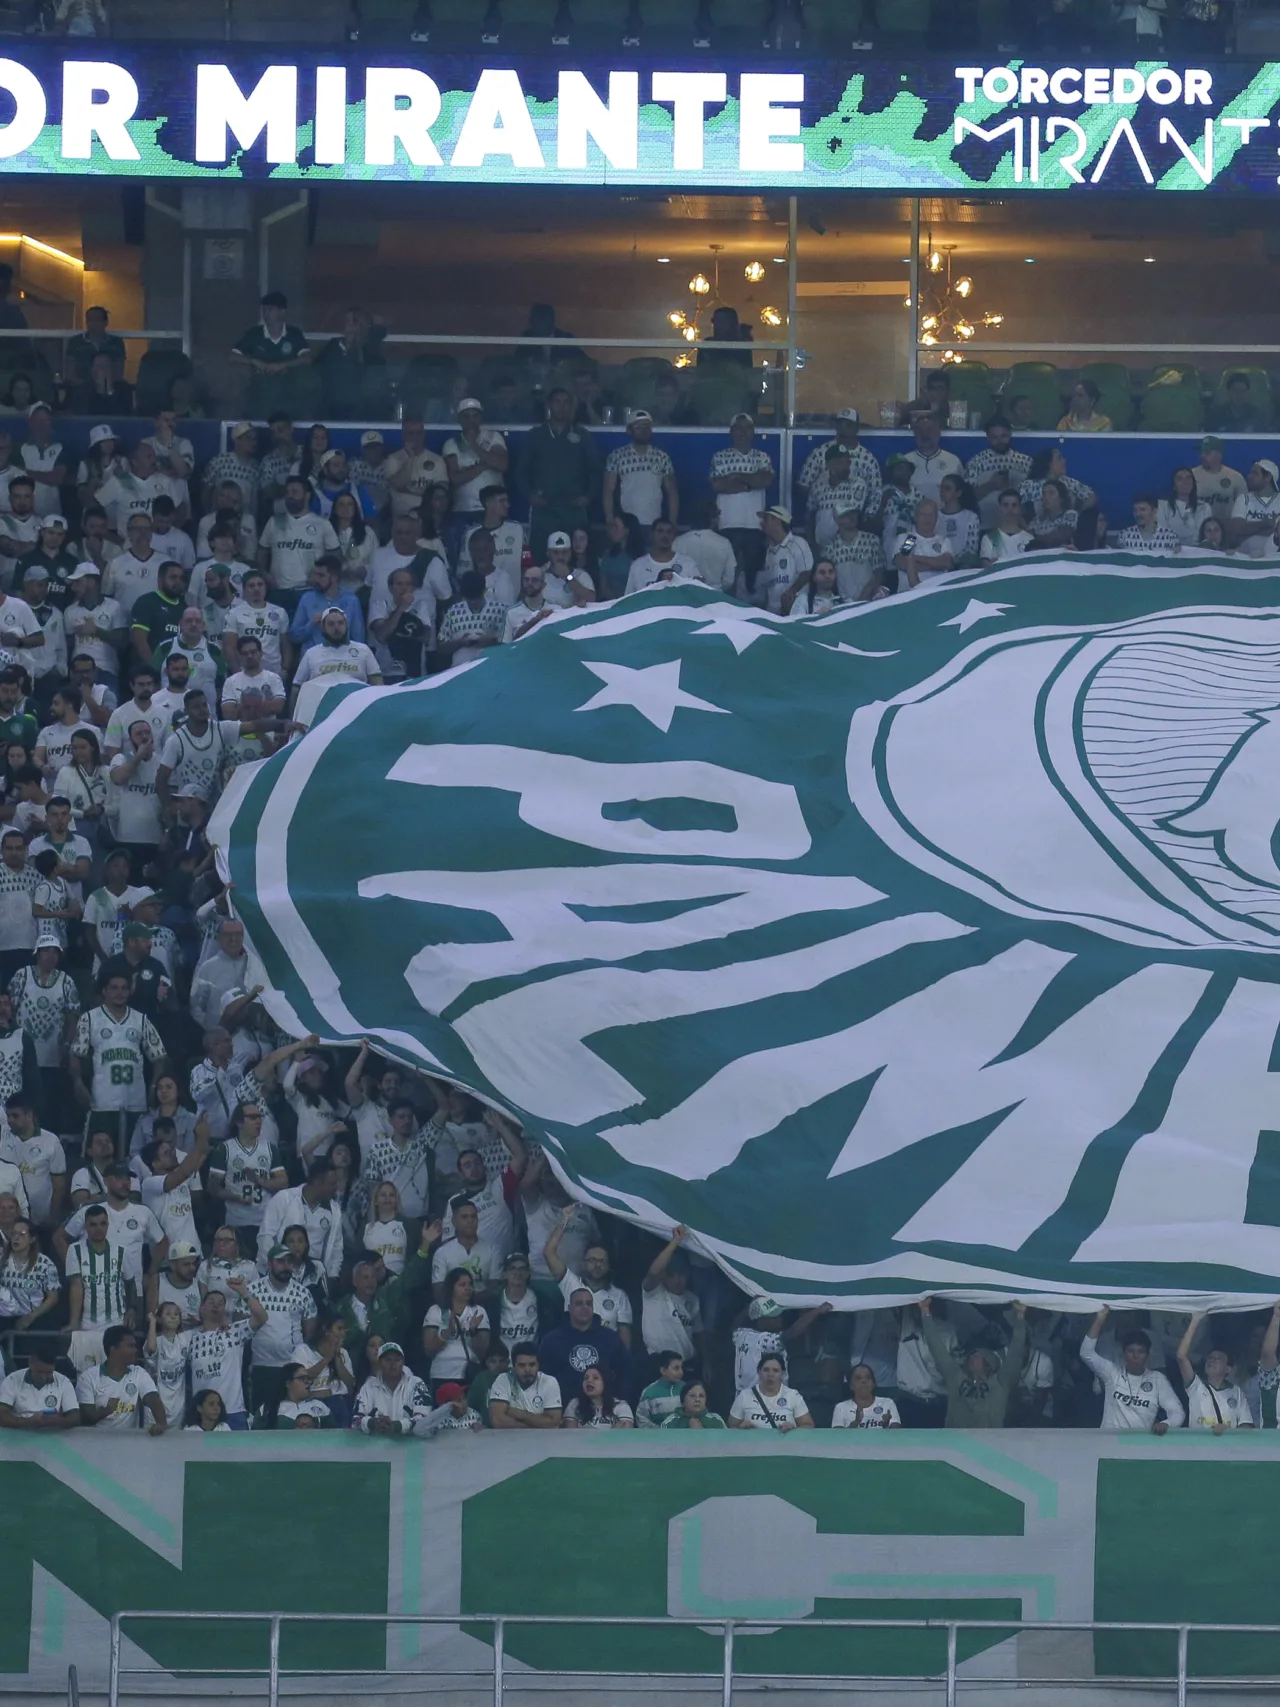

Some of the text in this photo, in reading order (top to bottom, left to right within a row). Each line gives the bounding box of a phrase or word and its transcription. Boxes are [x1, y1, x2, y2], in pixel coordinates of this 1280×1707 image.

[955, 66, 1214, 106] TORCEDOR
[194, 63, 806, 171] MIRANTE
[277, 539, 313, 551] crefisa
[244, 625, 279, 637] crefisa
[319, 662, 359, 673] crefisa
[110, 1065, 134, 1085] 83
[1113, 1391, 1151, 1409] crefisa
